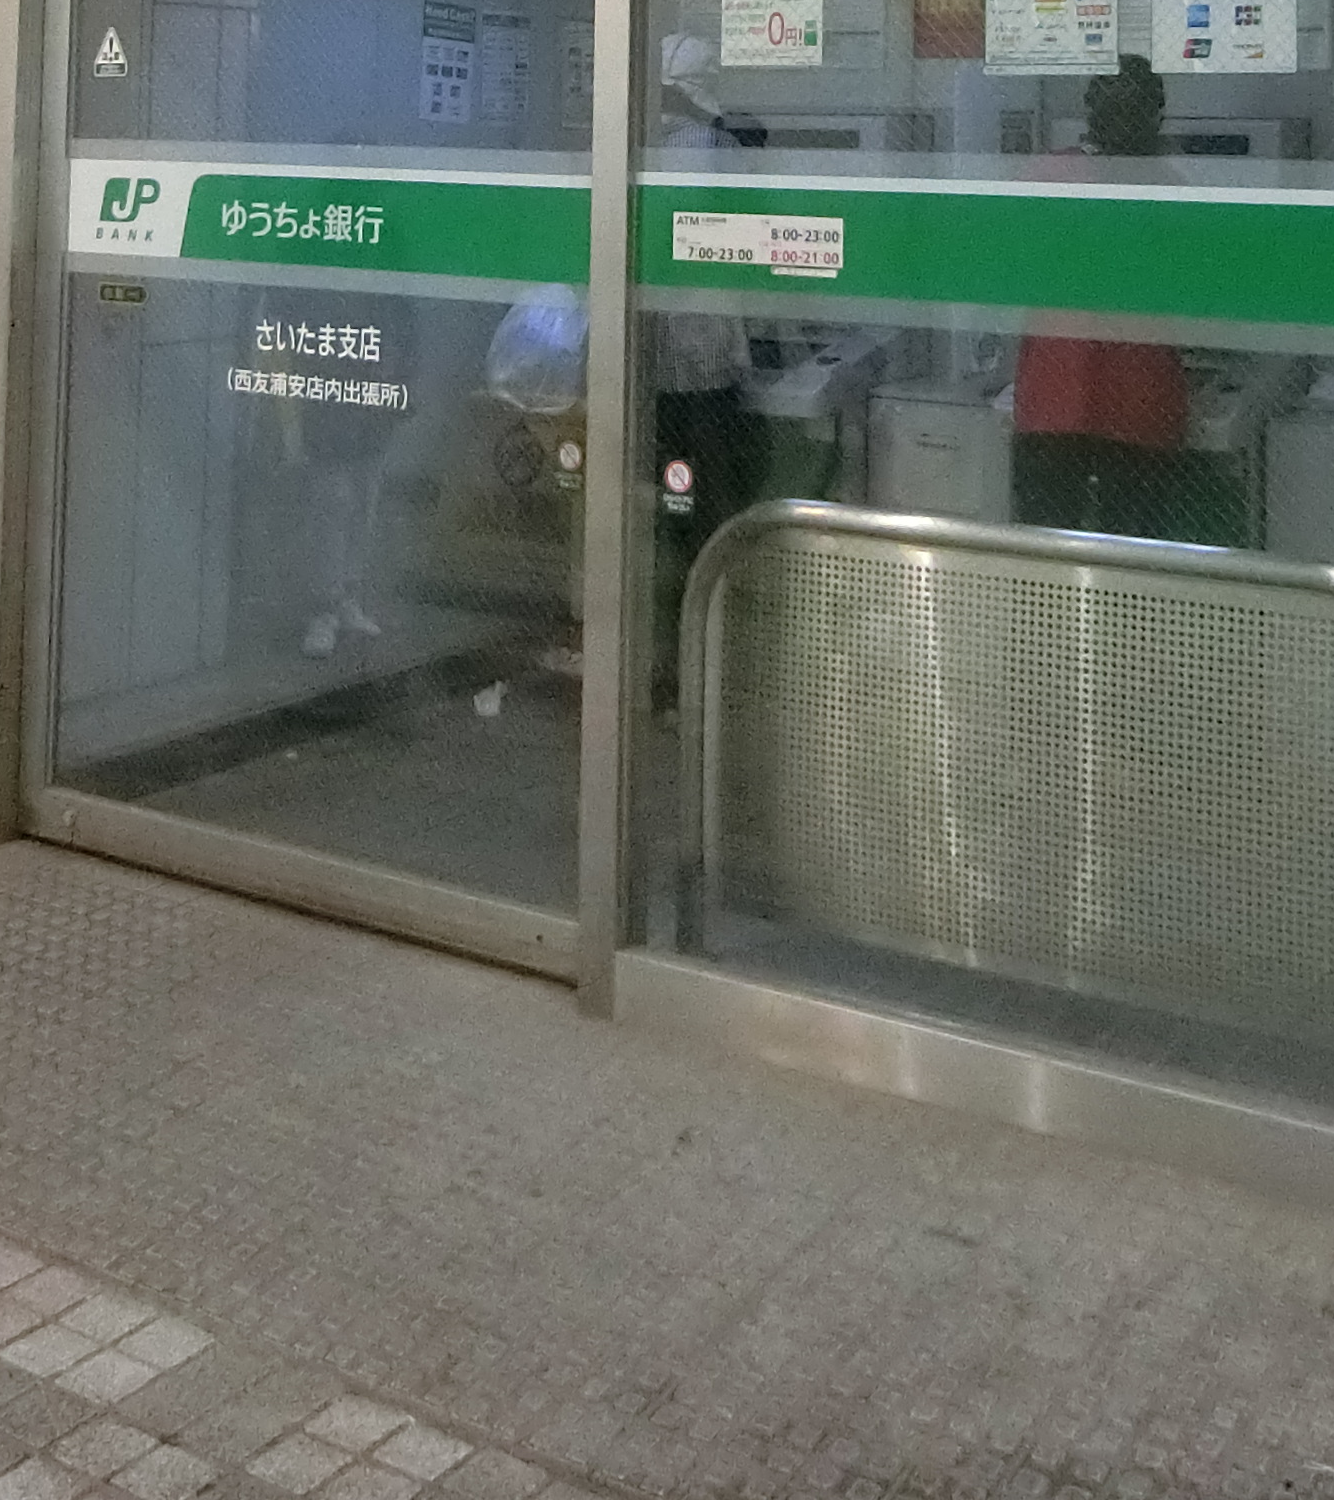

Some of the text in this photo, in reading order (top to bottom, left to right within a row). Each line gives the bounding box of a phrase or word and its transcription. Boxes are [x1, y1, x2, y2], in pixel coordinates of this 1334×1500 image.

[100, 177, 161, 222] JP
[676, 216, 700, 226] ATM
[96, 227, 154, 243] BANK
[221, 200, 384, 244] ゆうちょ銀行
[256, 319, 382, 362] さいたま支店
